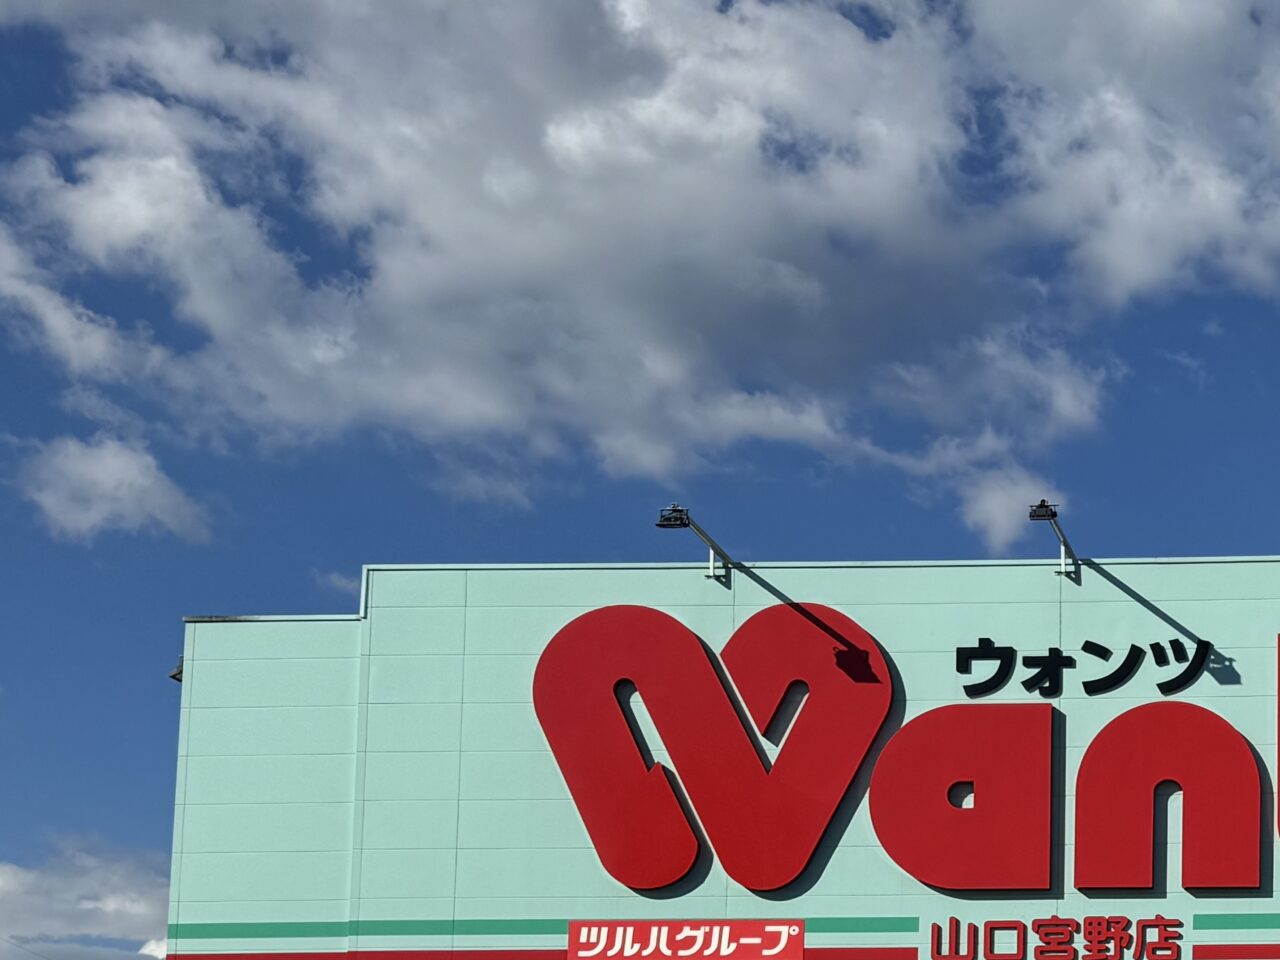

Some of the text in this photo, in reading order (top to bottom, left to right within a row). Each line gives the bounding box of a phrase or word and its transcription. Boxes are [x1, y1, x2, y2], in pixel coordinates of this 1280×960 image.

[956, 637, 1211, 698] ウォンツ
[577, 924, 799, 958] ツルハグループ
